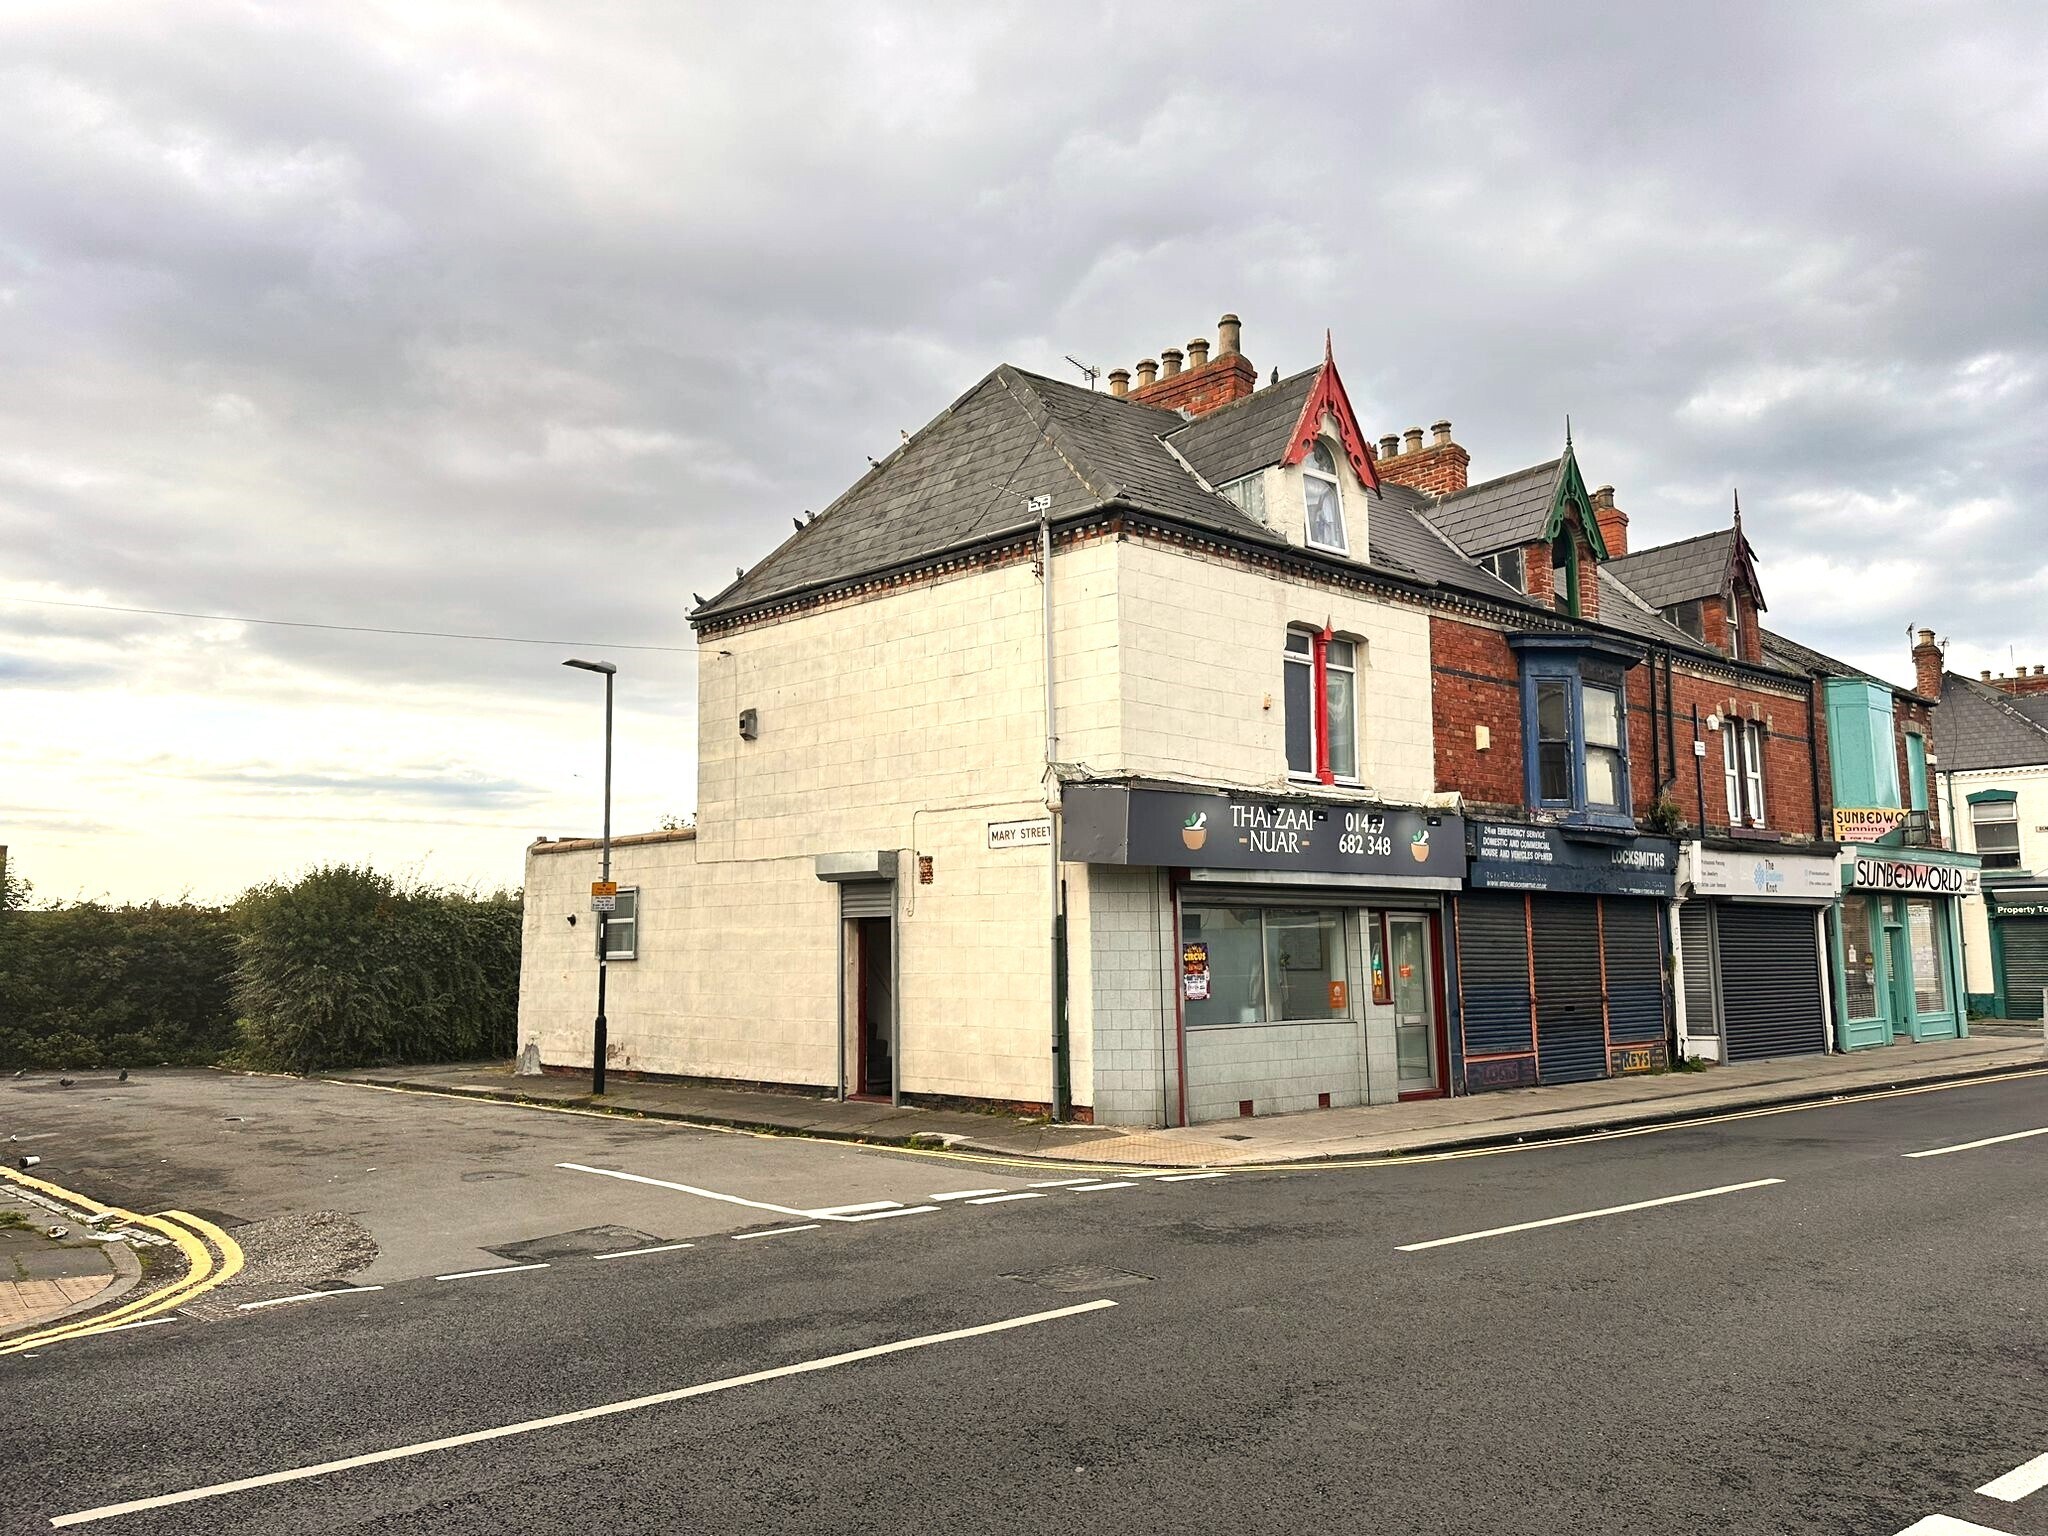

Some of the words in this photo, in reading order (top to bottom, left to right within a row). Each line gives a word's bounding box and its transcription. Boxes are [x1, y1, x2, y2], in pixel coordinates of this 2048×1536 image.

[991, 829, 1016, 841] MARY
[1020, 826, 1051, 839] STREET
[1497, 827, 1525, 837] EMERGENCY
[1526, 830, 1546, 839] SERVICE
[1838, 825, 1886, 833] Tanning
[1249, 830, 1300, 853] NUAR
[1339, 834, 1364, 854] 682
[1367, 835, 1391, 855] 348
[1482, 837, 1508, 846] DOMESTIC
[1509, 839, 1520, 848] AND
[1520, 840, 1550, 850] COMMERCIAL
[1480, 848, 1498, 857] HOUSE
[1499, 849, 1510, 858] AND
[1611, 850, 1665, 867] LOCKSMITHS
[1765, 859, 1775, 871] The
[1997, 905, 2035, 915] Property
[1184, 952, 1206, 961] CIRCUS
[1623, 1052, 1649, 1068] KEYS
